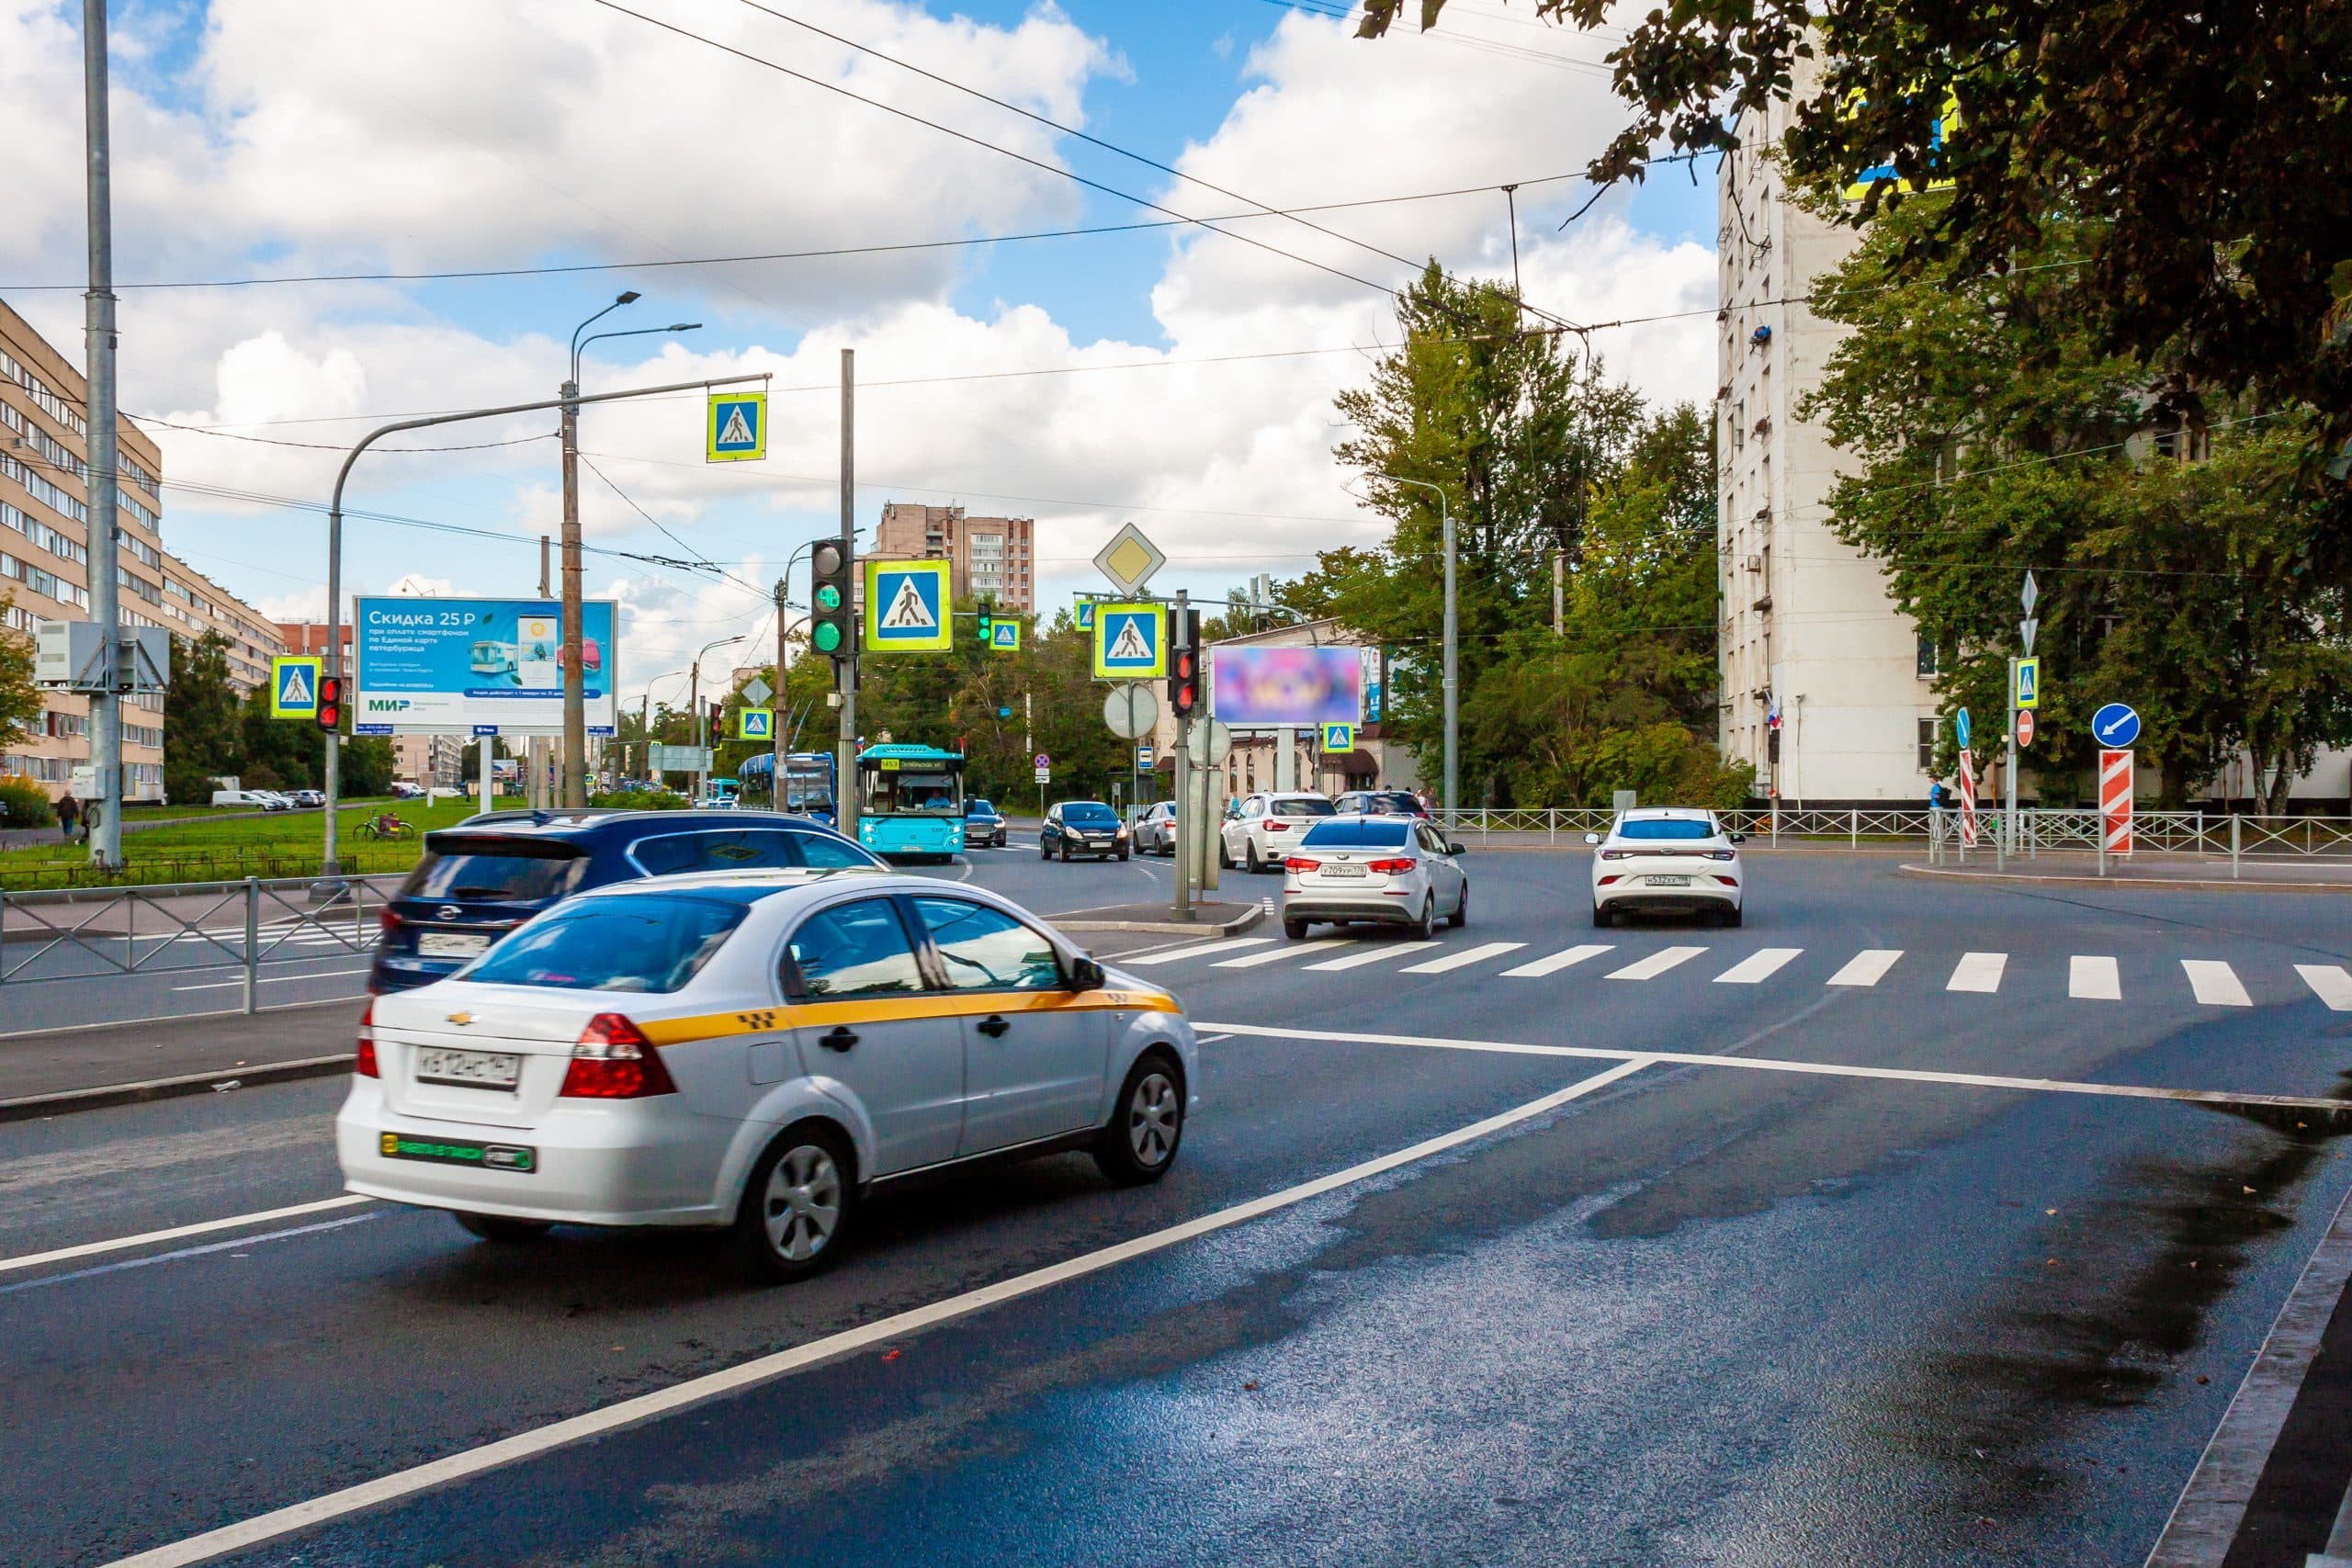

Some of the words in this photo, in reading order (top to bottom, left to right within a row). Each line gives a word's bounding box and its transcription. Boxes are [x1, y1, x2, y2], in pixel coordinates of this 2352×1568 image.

[368, 610, 434, 626] Скидка
[440, 613, 460, 626] 25
[381, 636, 413, 644] Единой
[368, 699, 411, 712] МИР
